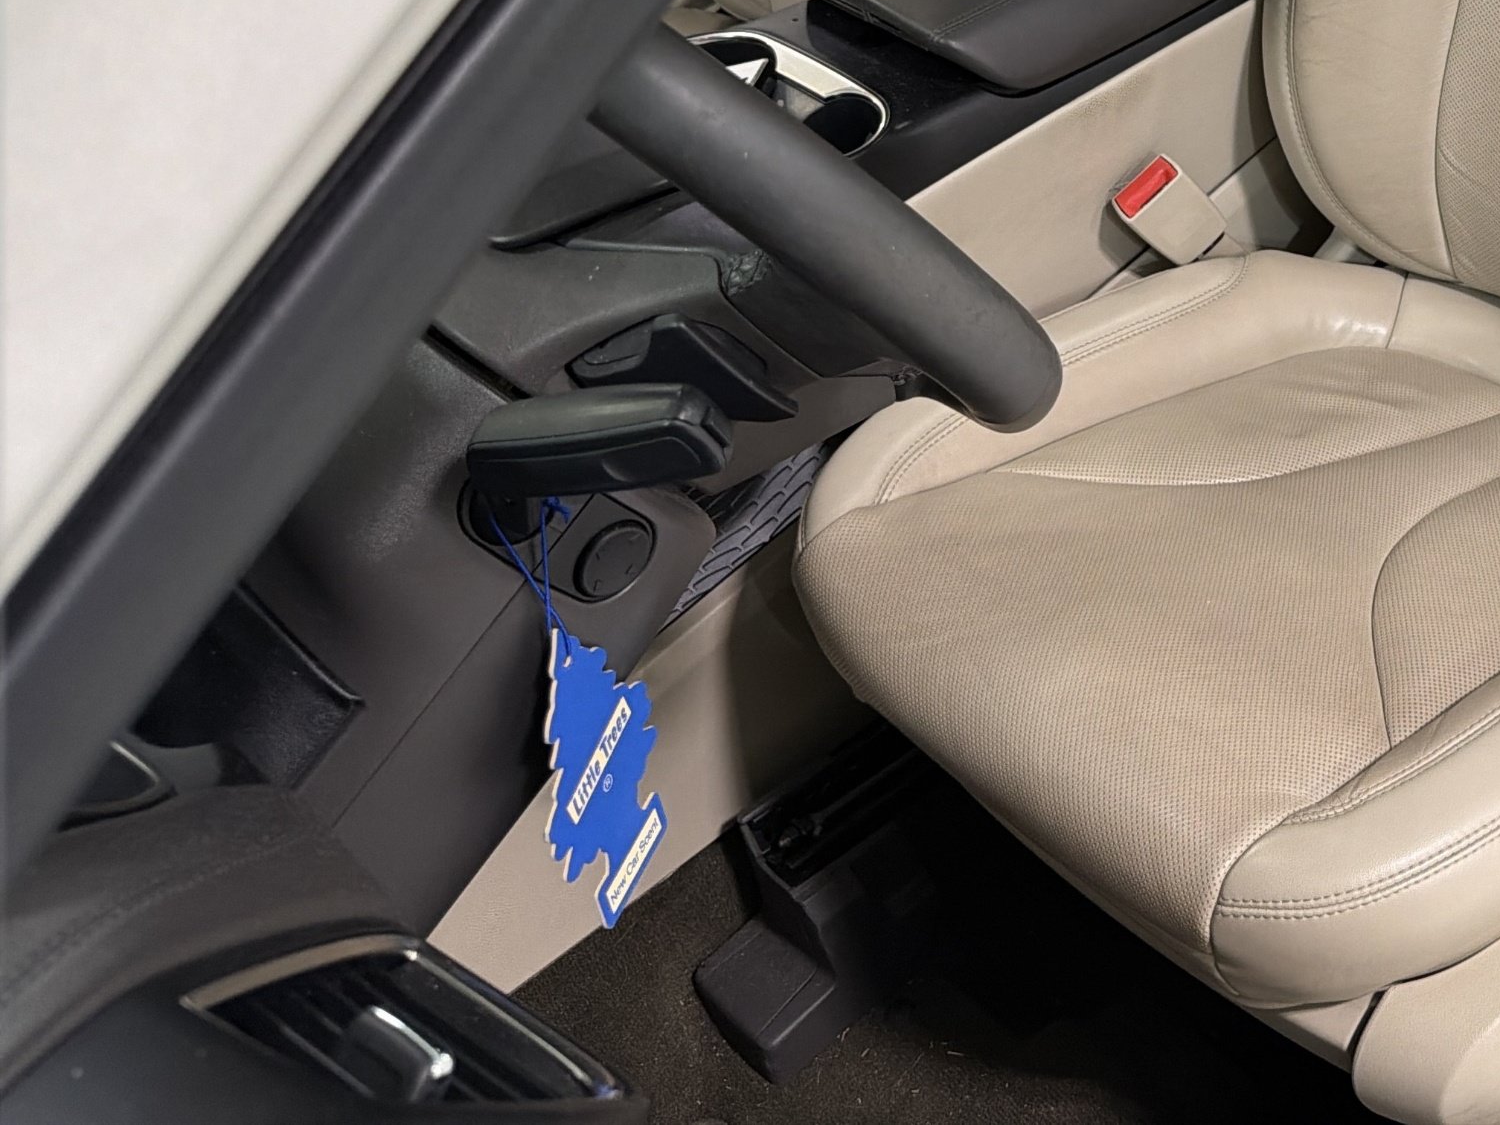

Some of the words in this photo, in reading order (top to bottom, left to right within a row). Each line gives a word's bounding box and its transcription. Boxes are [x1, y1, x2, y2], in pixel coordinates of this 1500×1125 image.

[573, 760, 601, 817] Little
[600, 707, 628, 758] Trees
[610, 878, 627, 904] New
[626, 850, 640, 876] Car
[639, 818, 659, 853] Scent
